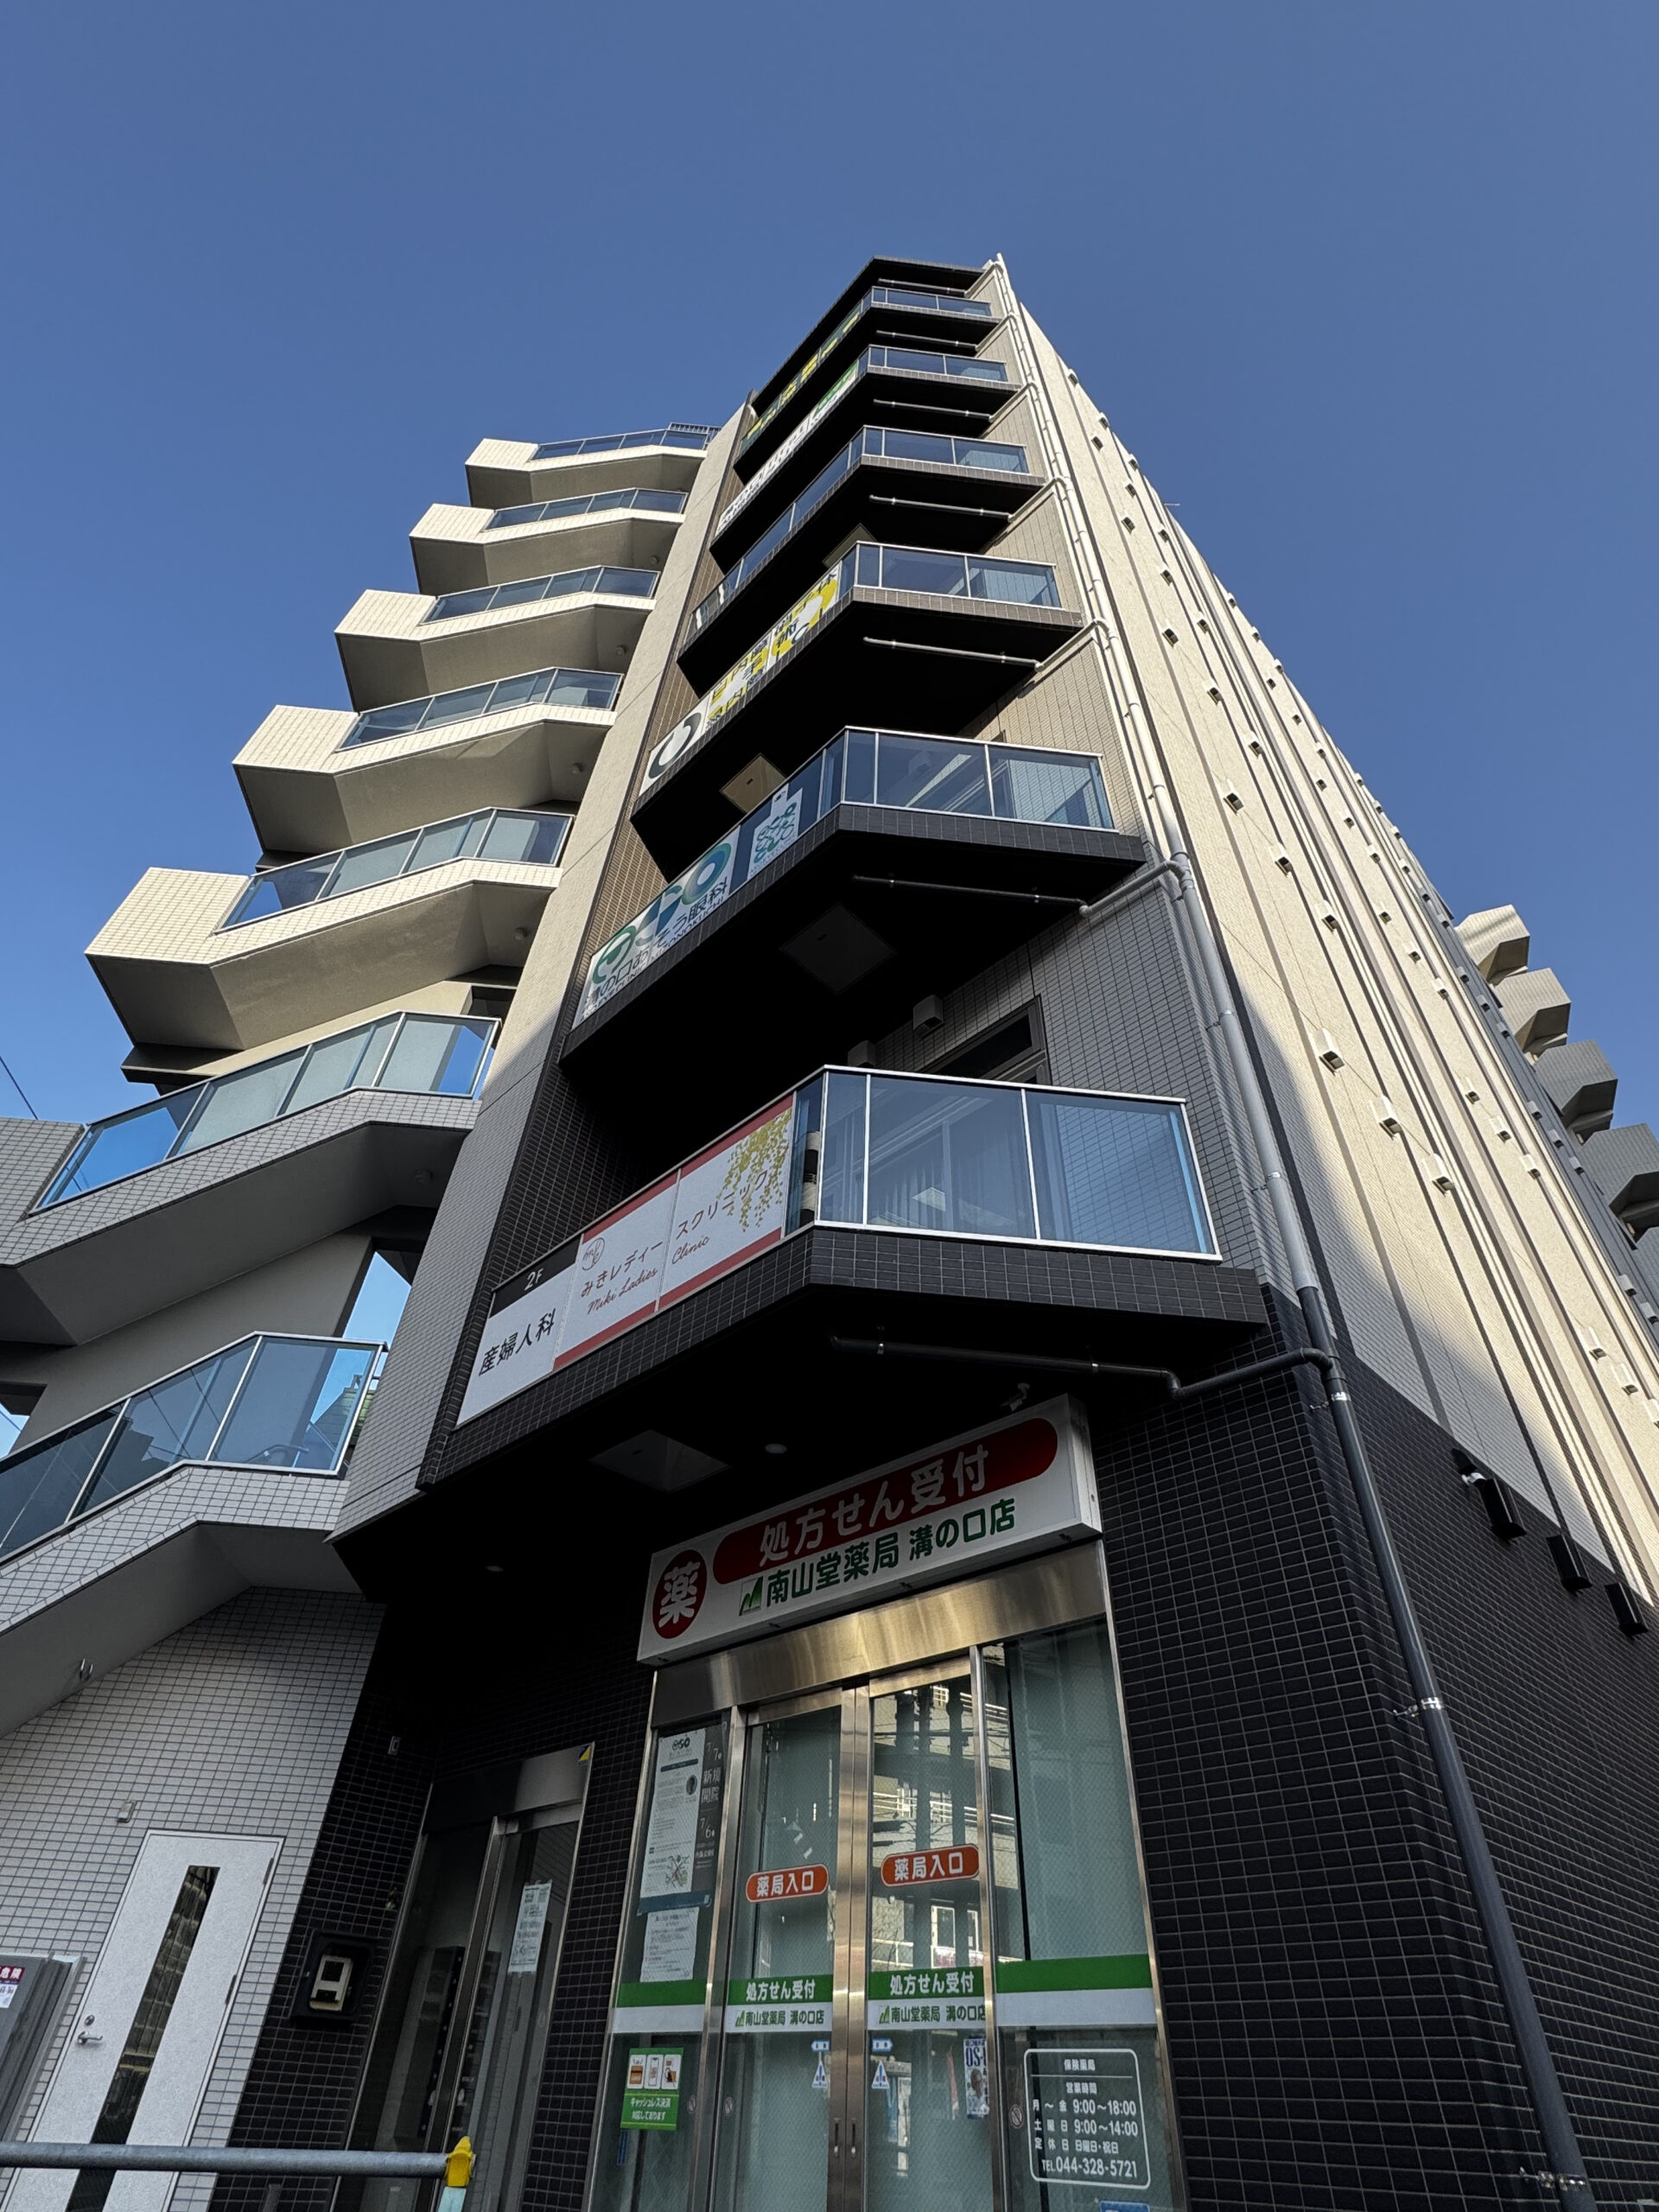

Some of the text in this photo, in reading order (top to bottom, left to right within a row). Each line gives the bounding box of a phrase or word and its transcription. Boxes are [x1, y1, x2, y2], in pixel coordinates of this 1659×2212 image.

[524, 1268, 544, 1292] 2F
[587, 1236, 710, 1315] Miki Ladies Clinic
[478, 1307, 556, 1376] 産婦人科
[759, 1444, 988, 1567] 処方せん受付
[766, 1497, 1015, 1607] 南山堂薬局 溝の口店
[658, 1560, 701, 1628] 薬
[893, 1851, 963, 1882] 薬局入口
[756, 1870, 815, 1897] 薬局入口
[0, 1967, 22, 1980] 危険
[890, 1971, 975, 1996] 処方せん受付
[746, 1979, 816, 2001] 処方せん受付
[745, 2009, 825, 2026] 南山堂薬局 溝の口店
[891, 2005, 986, 2023] 南山堂薬局 溝の口店
[1064, 2058, 1096, 2071] 保険薬局
[1065, 2082, 1097, 2094] 営業時間
